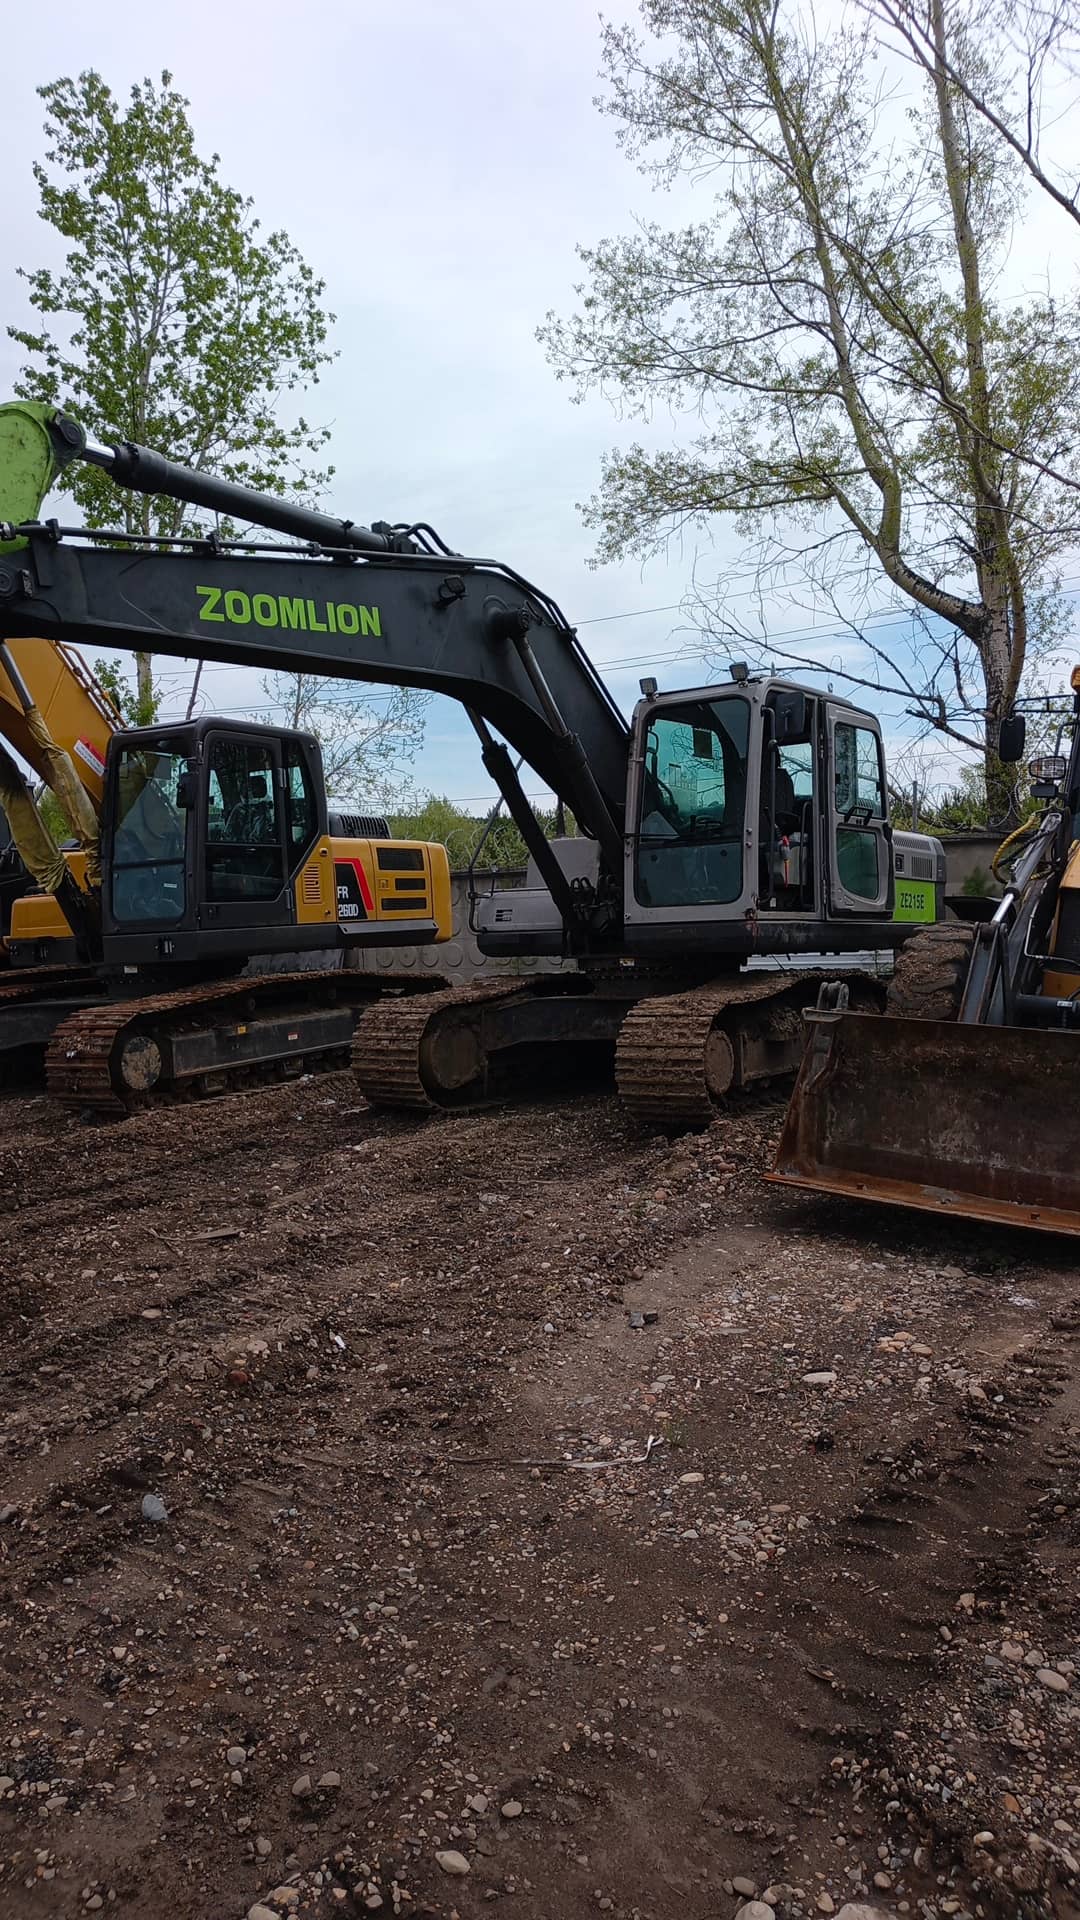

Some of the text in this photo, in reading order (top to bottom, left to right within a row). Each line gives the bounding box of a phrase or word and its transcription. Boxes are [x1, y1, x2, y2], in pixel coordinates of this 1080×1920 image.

[196, 585, 382, 637] ZOOMLION
[336, 886, 349, 899] FR
[900, 892, 925, 909] ZE215E
